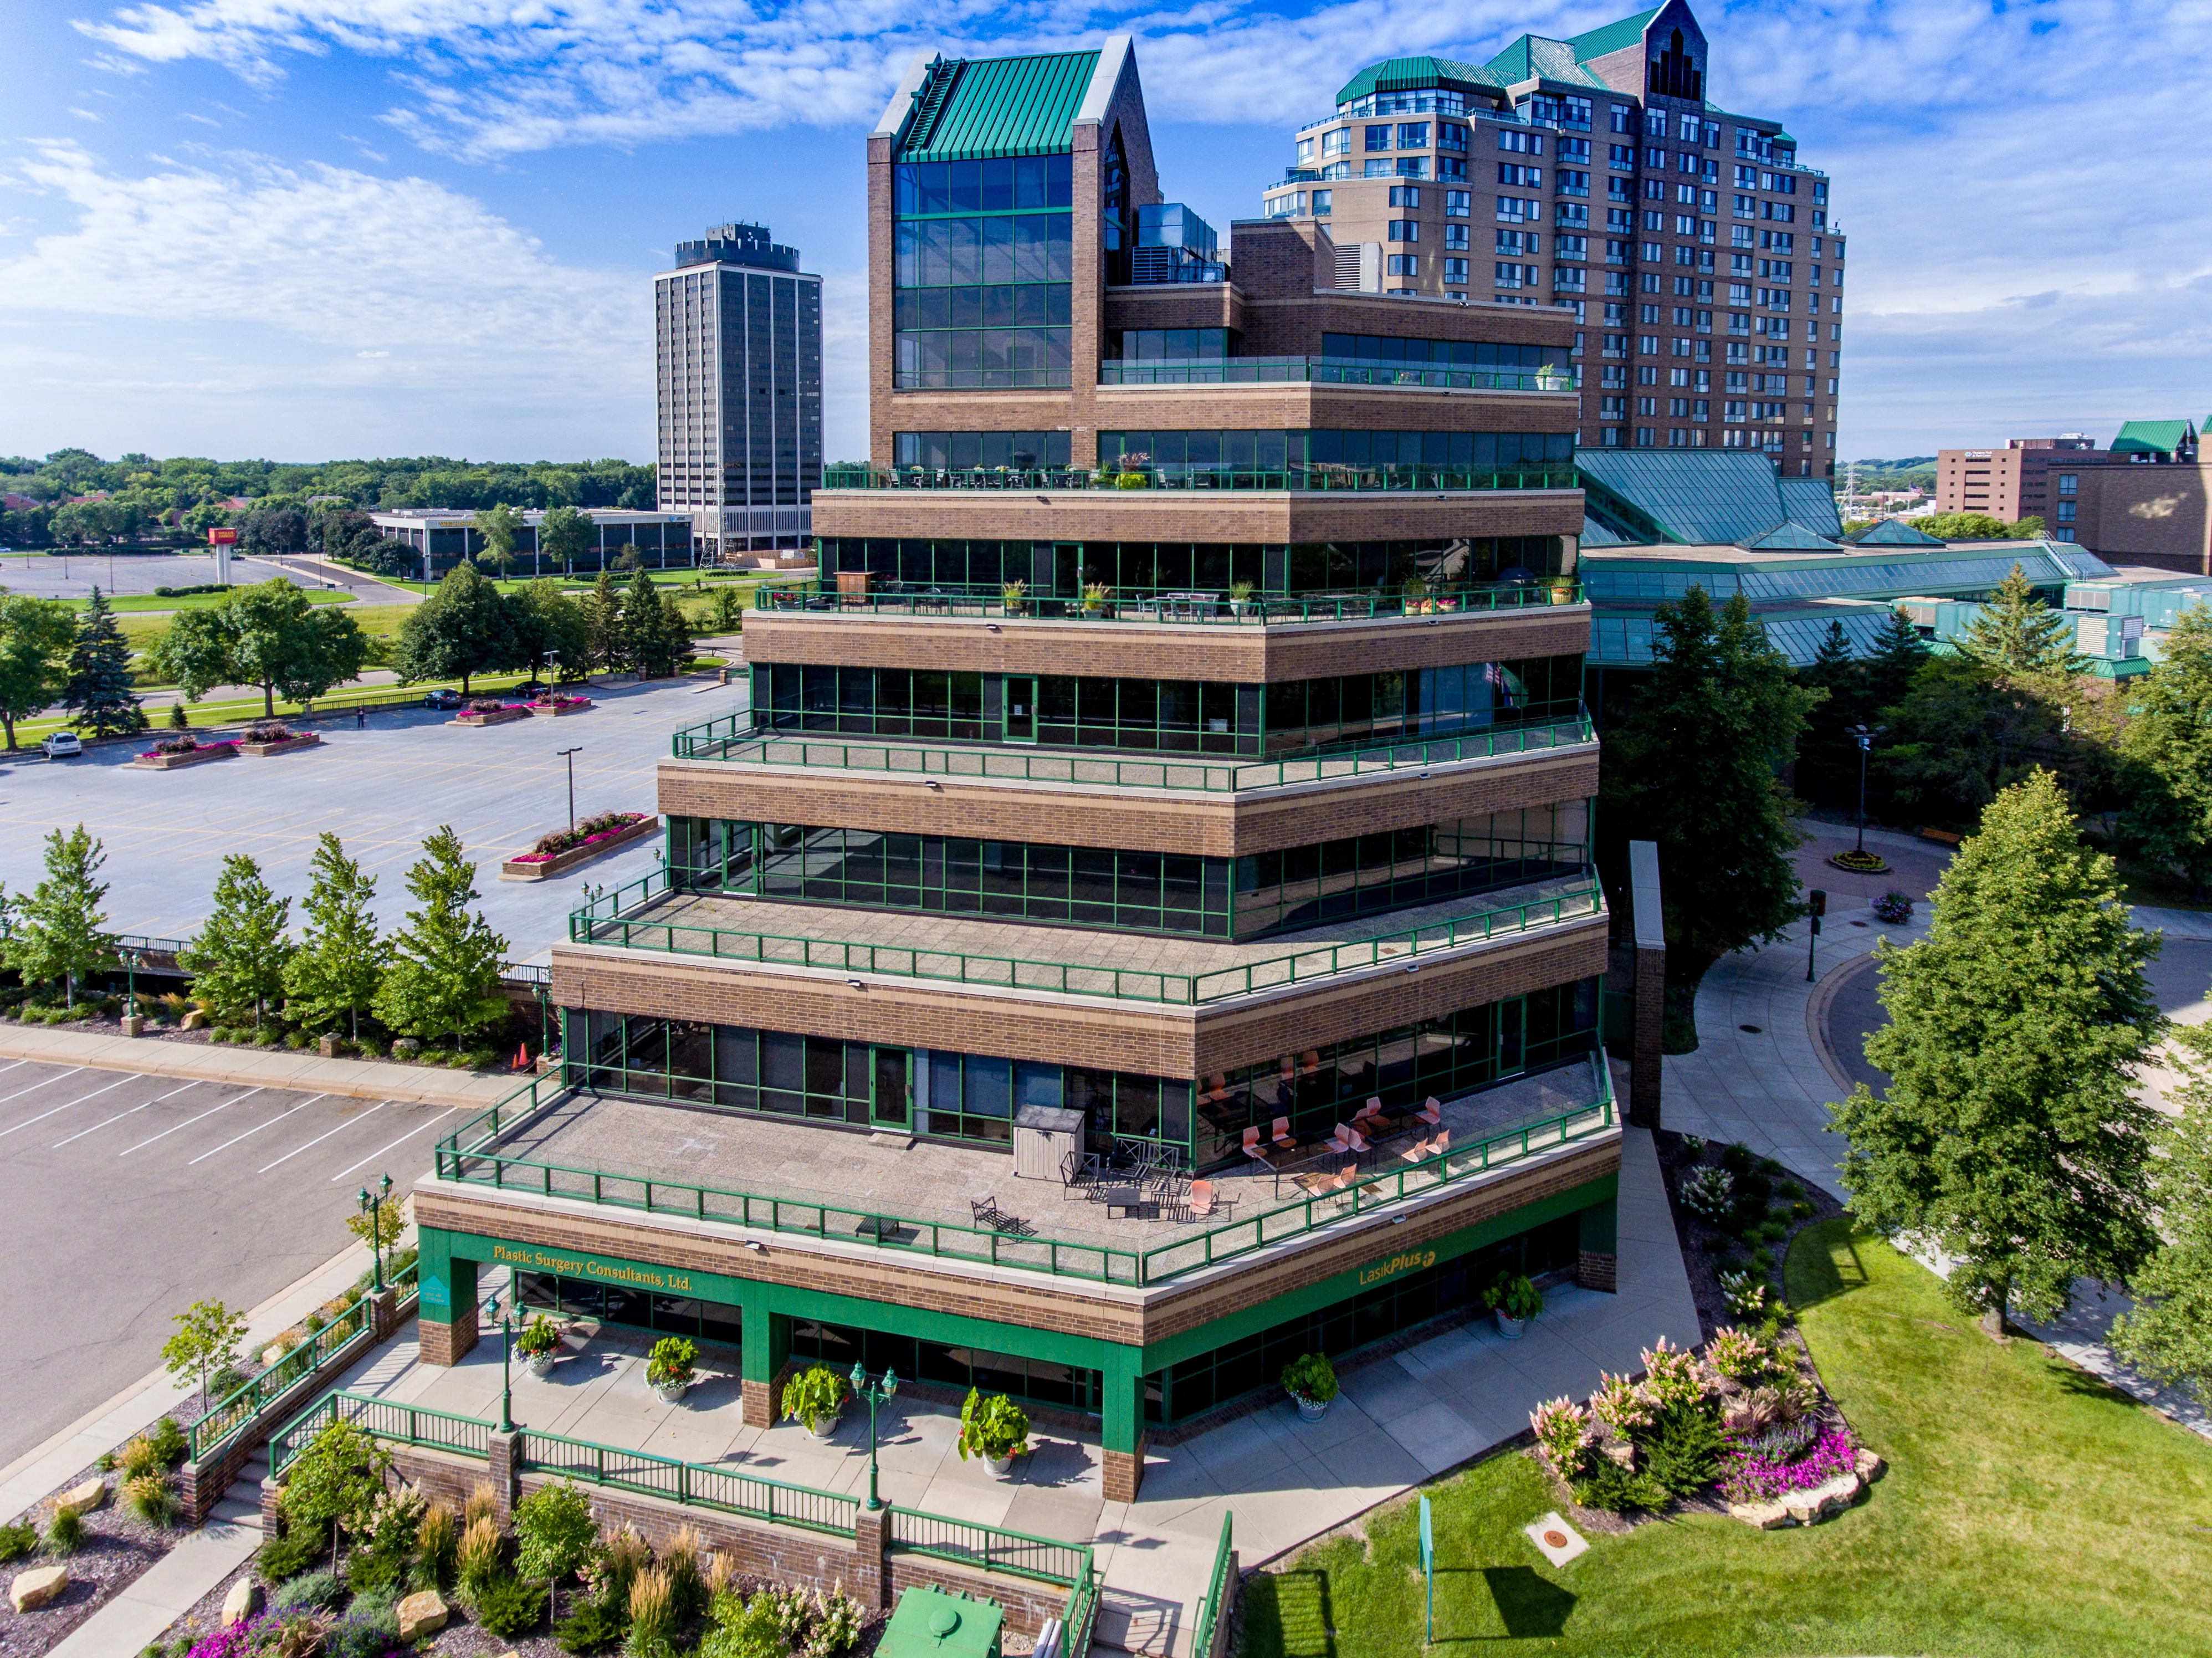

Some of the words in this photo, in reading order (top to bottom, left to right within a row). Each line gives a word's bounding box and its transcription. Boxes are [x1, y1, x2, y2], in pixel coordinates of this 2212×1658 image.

[493, 1246, 532, 1264] Plastic
[535, 1252, 584, 1275] Surgery
[586, 1261, 665, 1287] Consultants,
[668, 1275, 693, 1291] Ltd.
[1360, 1252, 1422, 1285] LasikPlus
